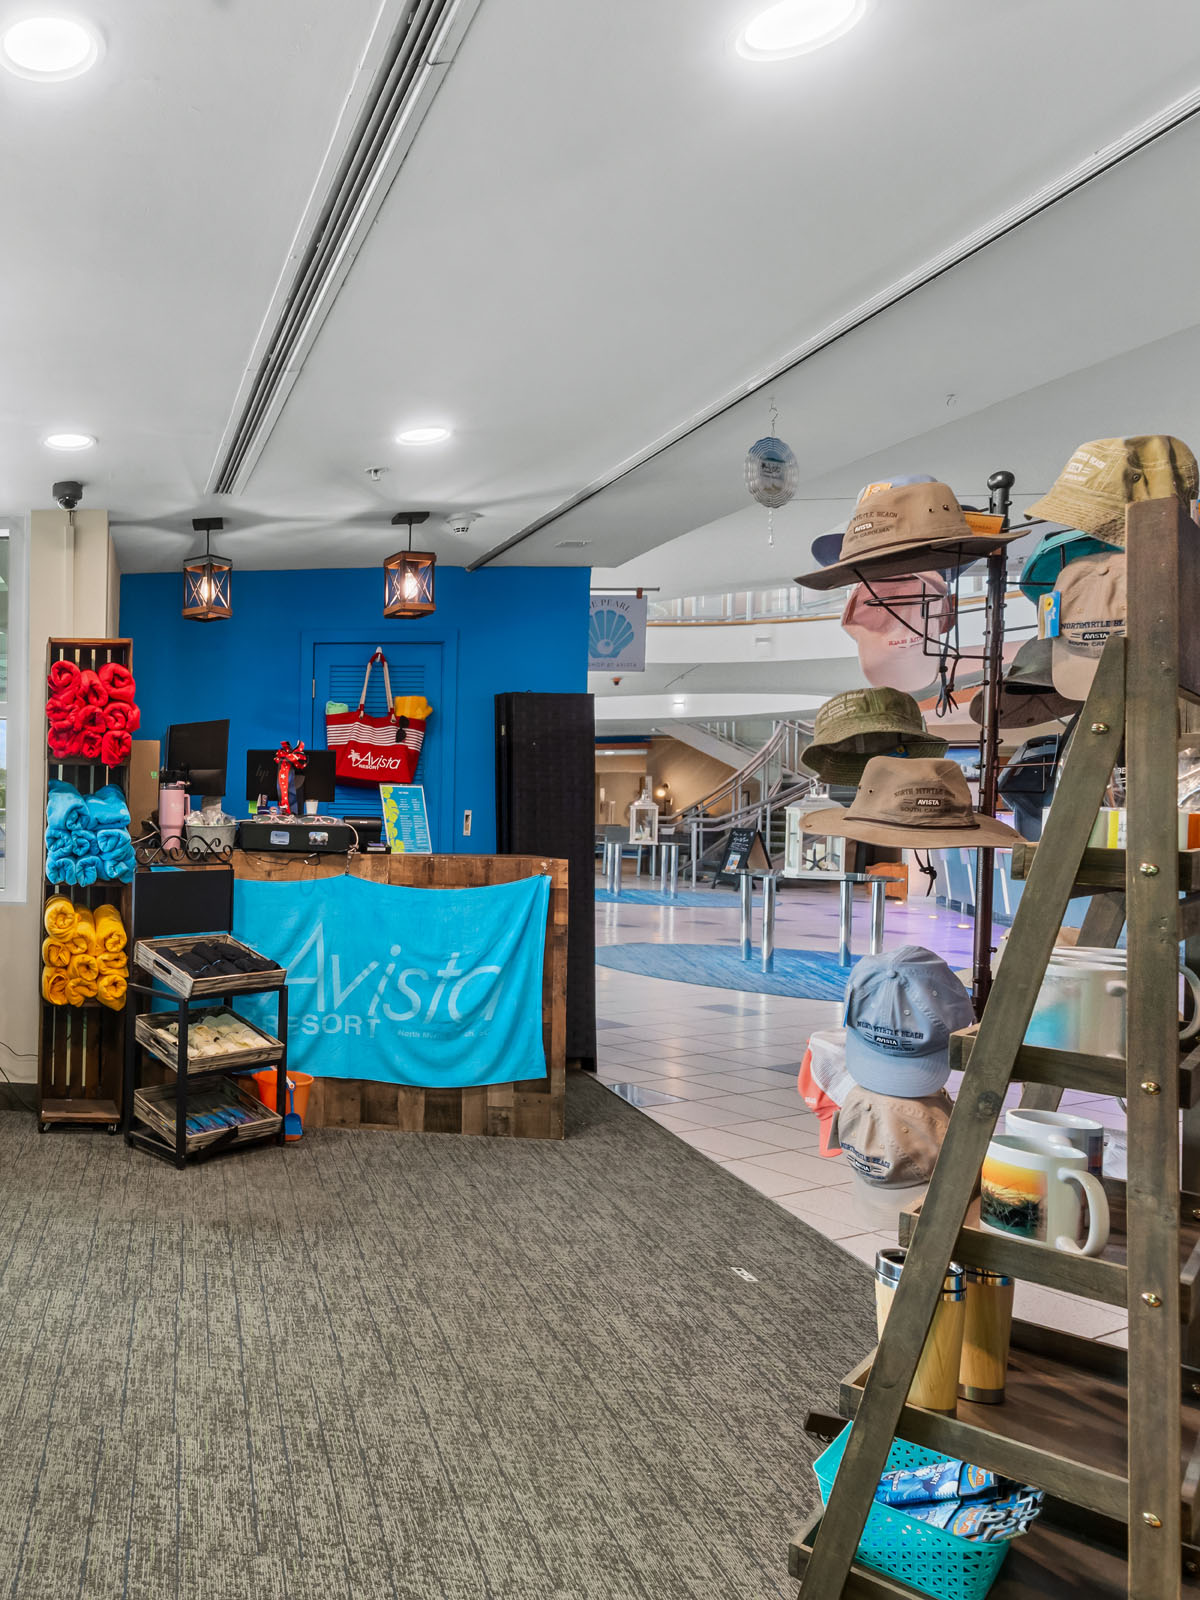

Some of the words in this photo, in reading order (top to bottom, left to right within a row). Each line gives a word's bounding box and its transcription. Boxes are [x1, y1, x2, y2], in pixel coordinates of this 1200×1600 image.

[352, 751, 400, 769] Avista
[258, 920, 502, 1024] Avista
[901, 1030, 924, 1039] BEACH
